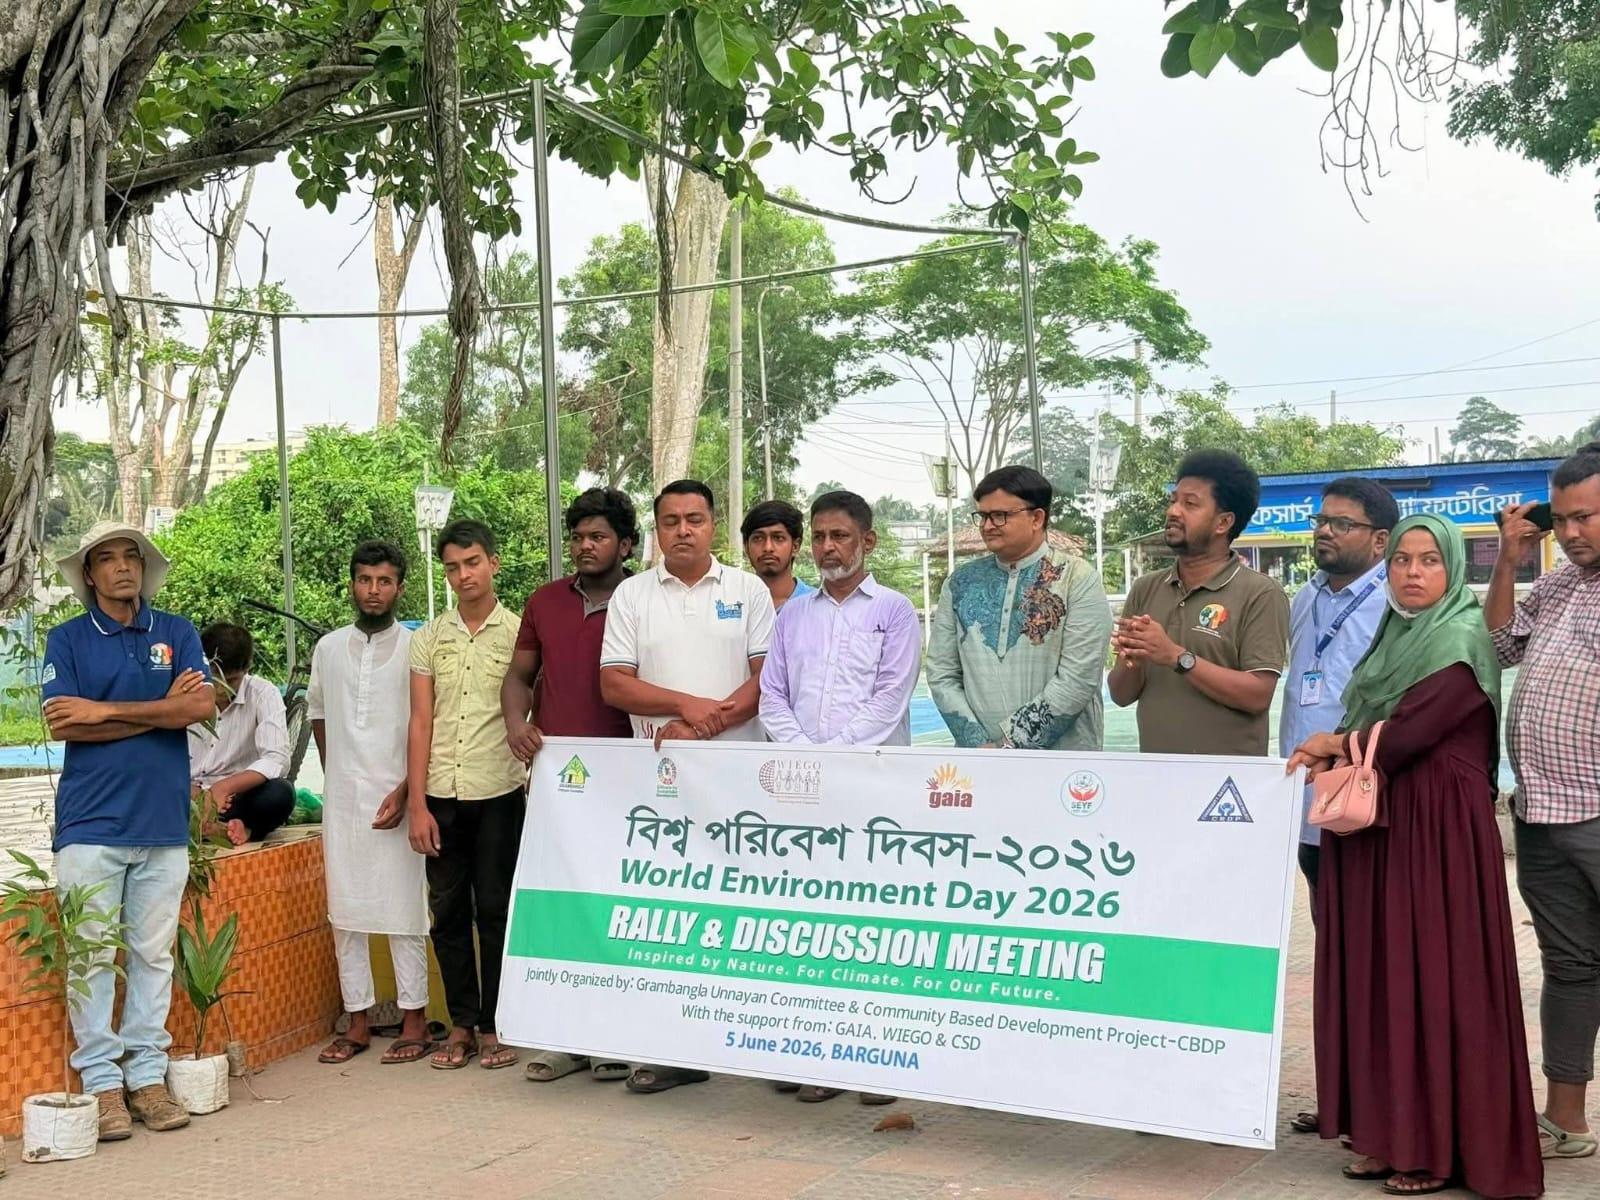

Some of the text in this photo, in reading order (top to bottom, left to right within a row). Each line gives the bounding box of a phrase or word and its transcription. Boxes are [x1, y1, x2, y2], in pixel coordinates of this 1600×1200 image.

[777, 759, 822, 770] WIEGO
[928, 789, 973, 808] gaia
[625, 805, 1136, 881] বিশ্ব পরিবেশ দিবস-২০২৬
[621, 858, 1120, 919] World Environment Day 2026
[607, 904, 1106, 984] RALLY & DISCUSSION MEETING
[627, 947, 1061, 1001] Inspired by Nature. For Climate. For Our Future.
[525, 967, 1226, 1055] Jointly Organized by: Grambangla Unnayan Committee & Community Based Development Project-CBDP
[681, 1003, 710, 1021] With
[713, 1008, 735, 1023] the
[737, 1011, 790, 1030] support
[792, 1015, 832, 1033] from:
[882, 1026, 932, 1046] WIEGO
[935, 1033, 947, 1047] &
[951, 1033, 981, 1051] CSD
[725, 1031, 920, 1070] 5 June 2026, BARGUNA
